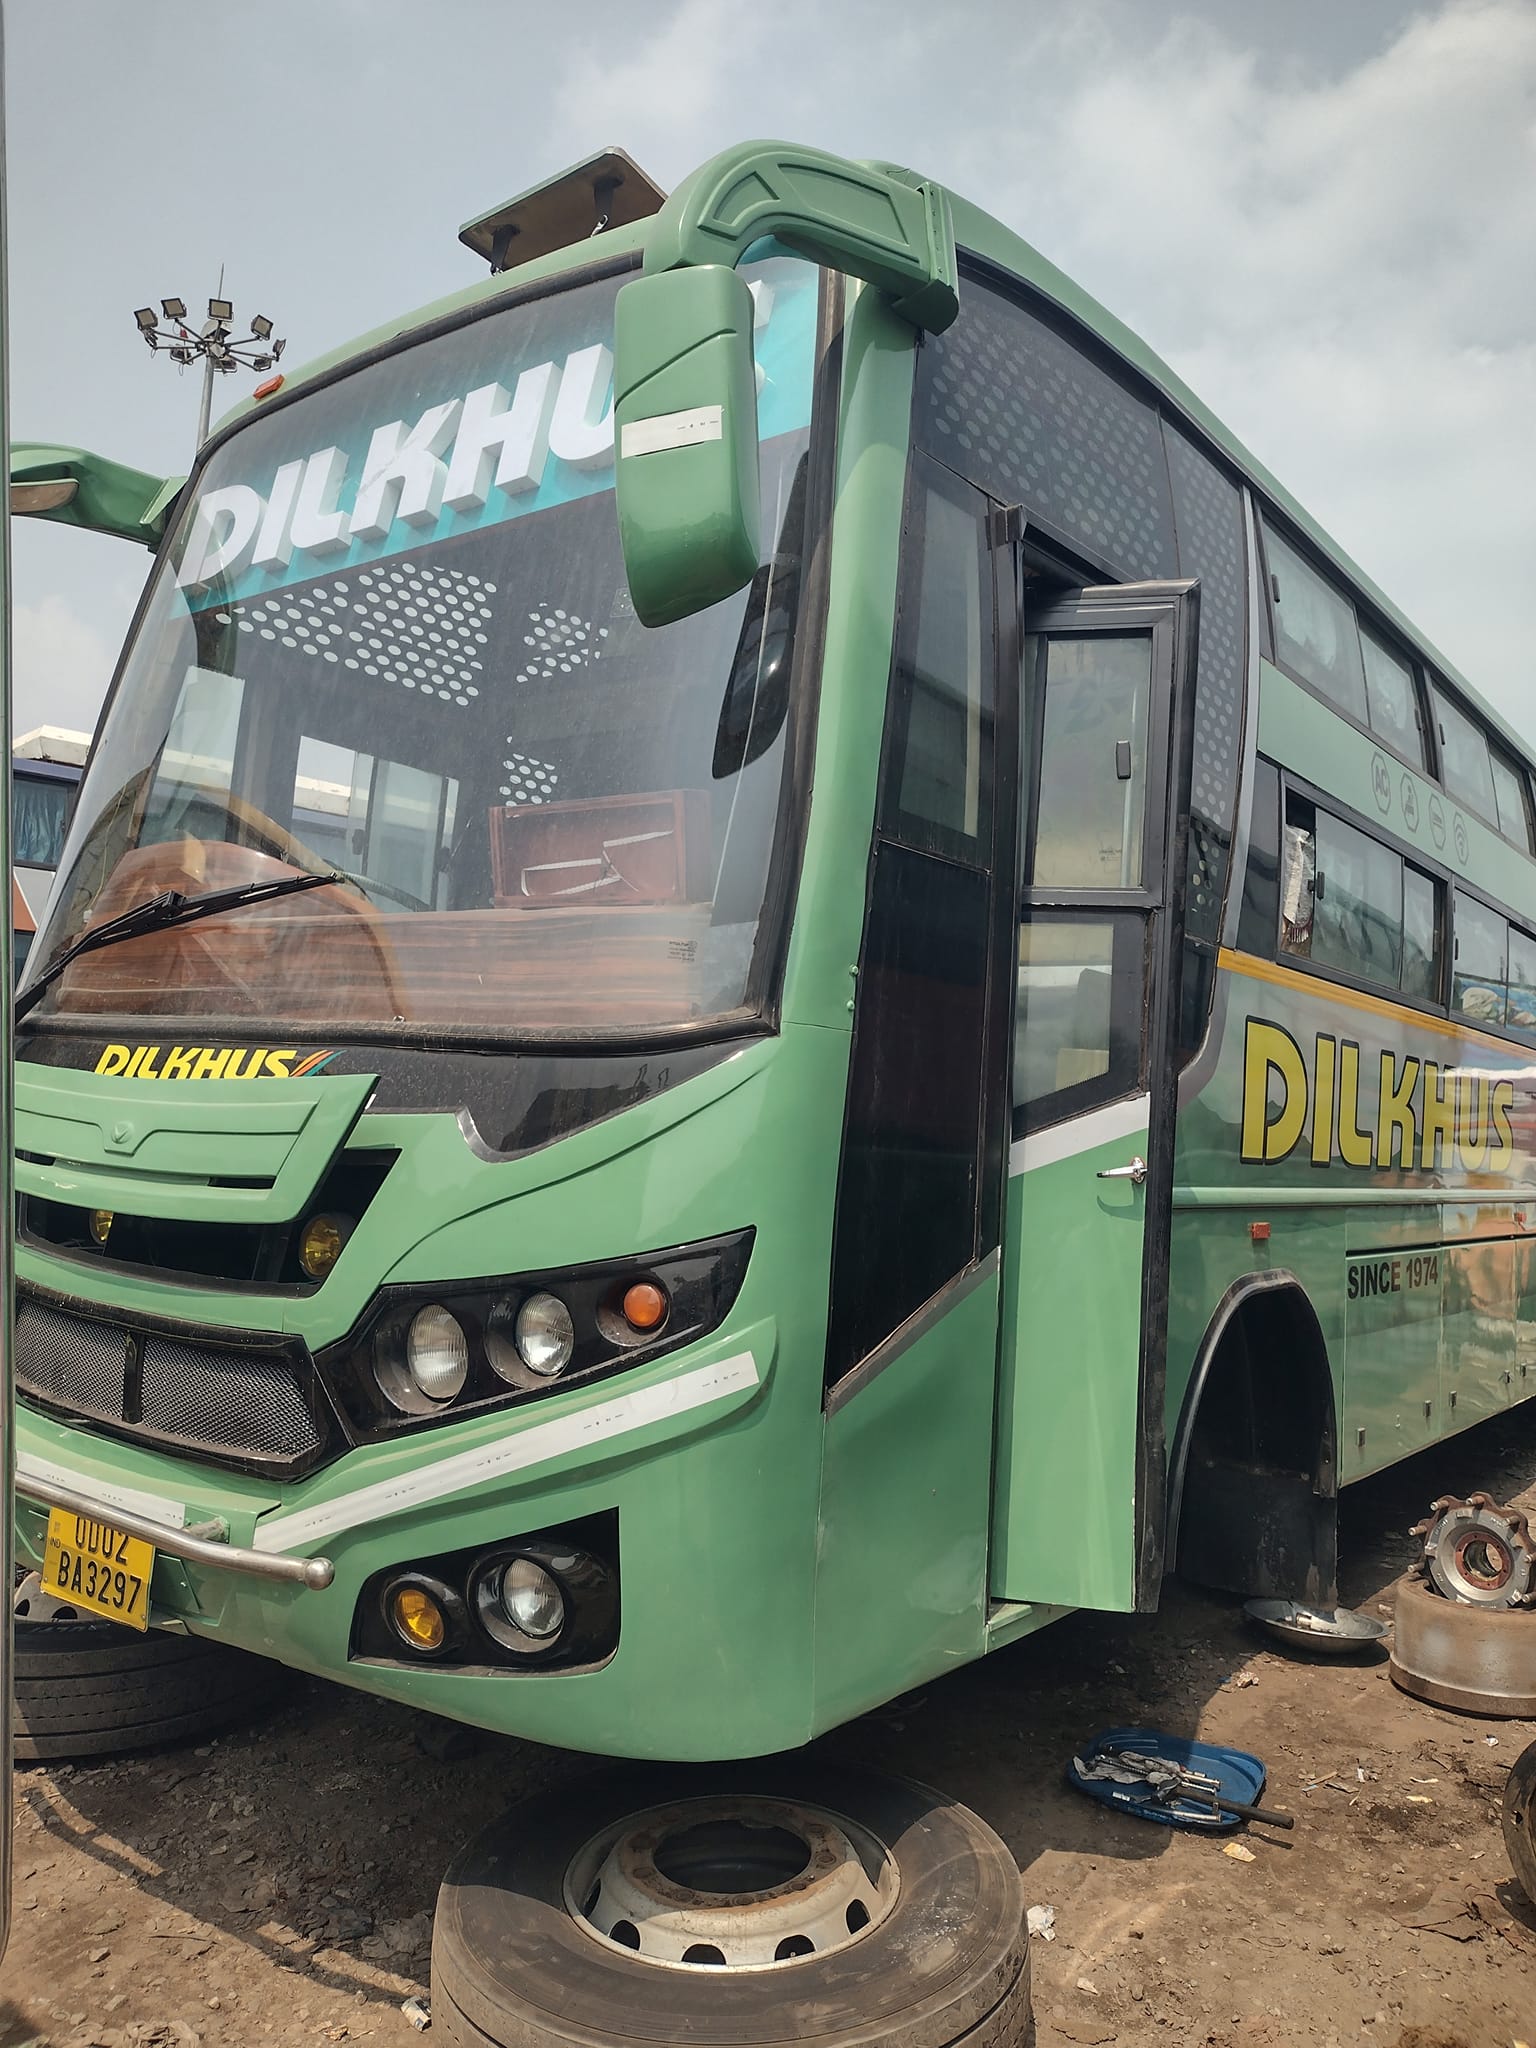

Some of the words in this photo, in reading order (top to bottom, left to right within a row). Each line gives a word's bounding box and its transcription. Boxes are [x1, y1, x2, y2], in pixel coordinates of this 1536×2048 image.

[174, 280, 775, 596] DILKHU
[95, 1044, 297, 1080] DILKHUS
[1240, 1015, 1514, 1174] DILKHUS
[1347, 1262, 1401, 1299] SINCE
[1406, 1256, 1438, 1288] 1974
[58, 1551, 142, 1613] BA3297
